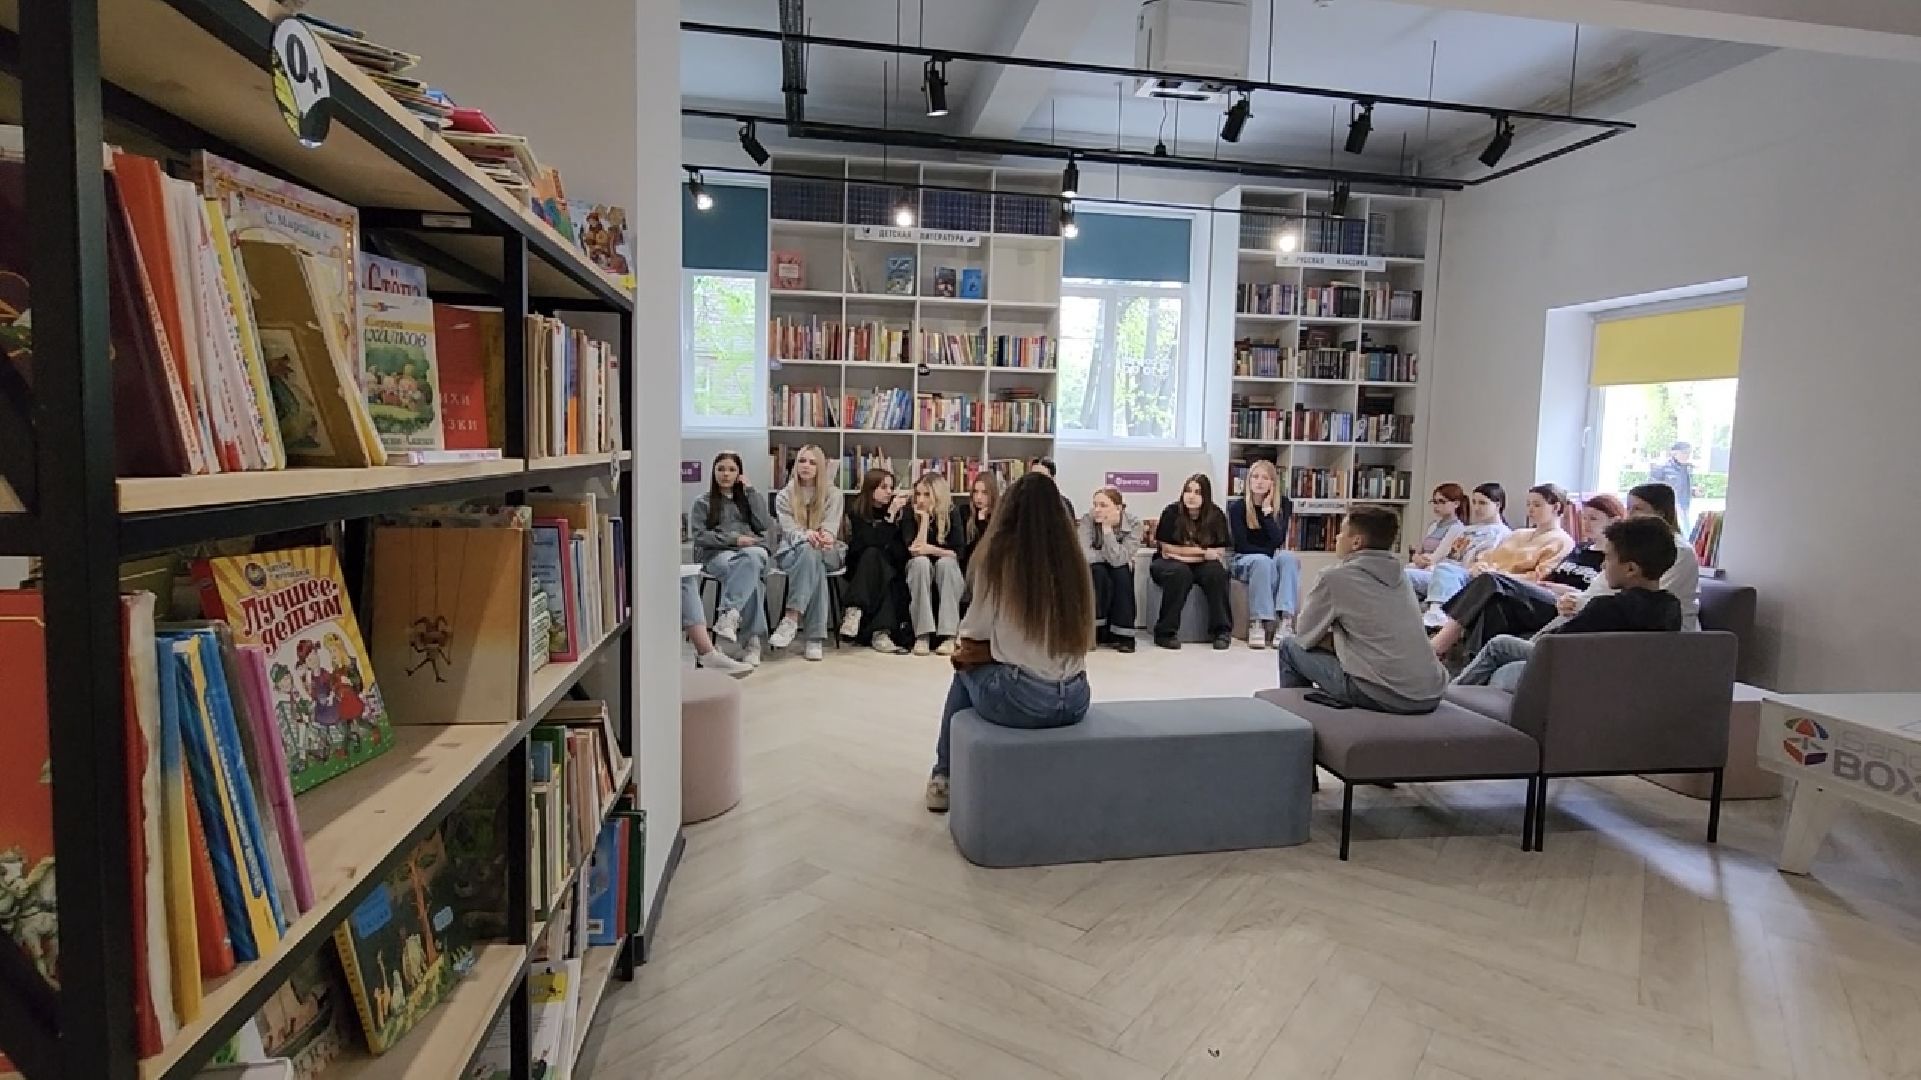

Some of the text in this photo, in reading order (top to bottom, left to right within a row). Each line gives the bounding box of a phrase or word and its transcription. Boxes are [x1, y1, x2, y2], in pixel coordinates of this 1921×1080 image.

[286, 33, 323, 95] 0+
[878, 229, 965, 242] ДЕТСКАЯ ЛИТЕРАТУРА
[1296, 256, 1369, 267] РУССКАЯ КЛАССИКА
